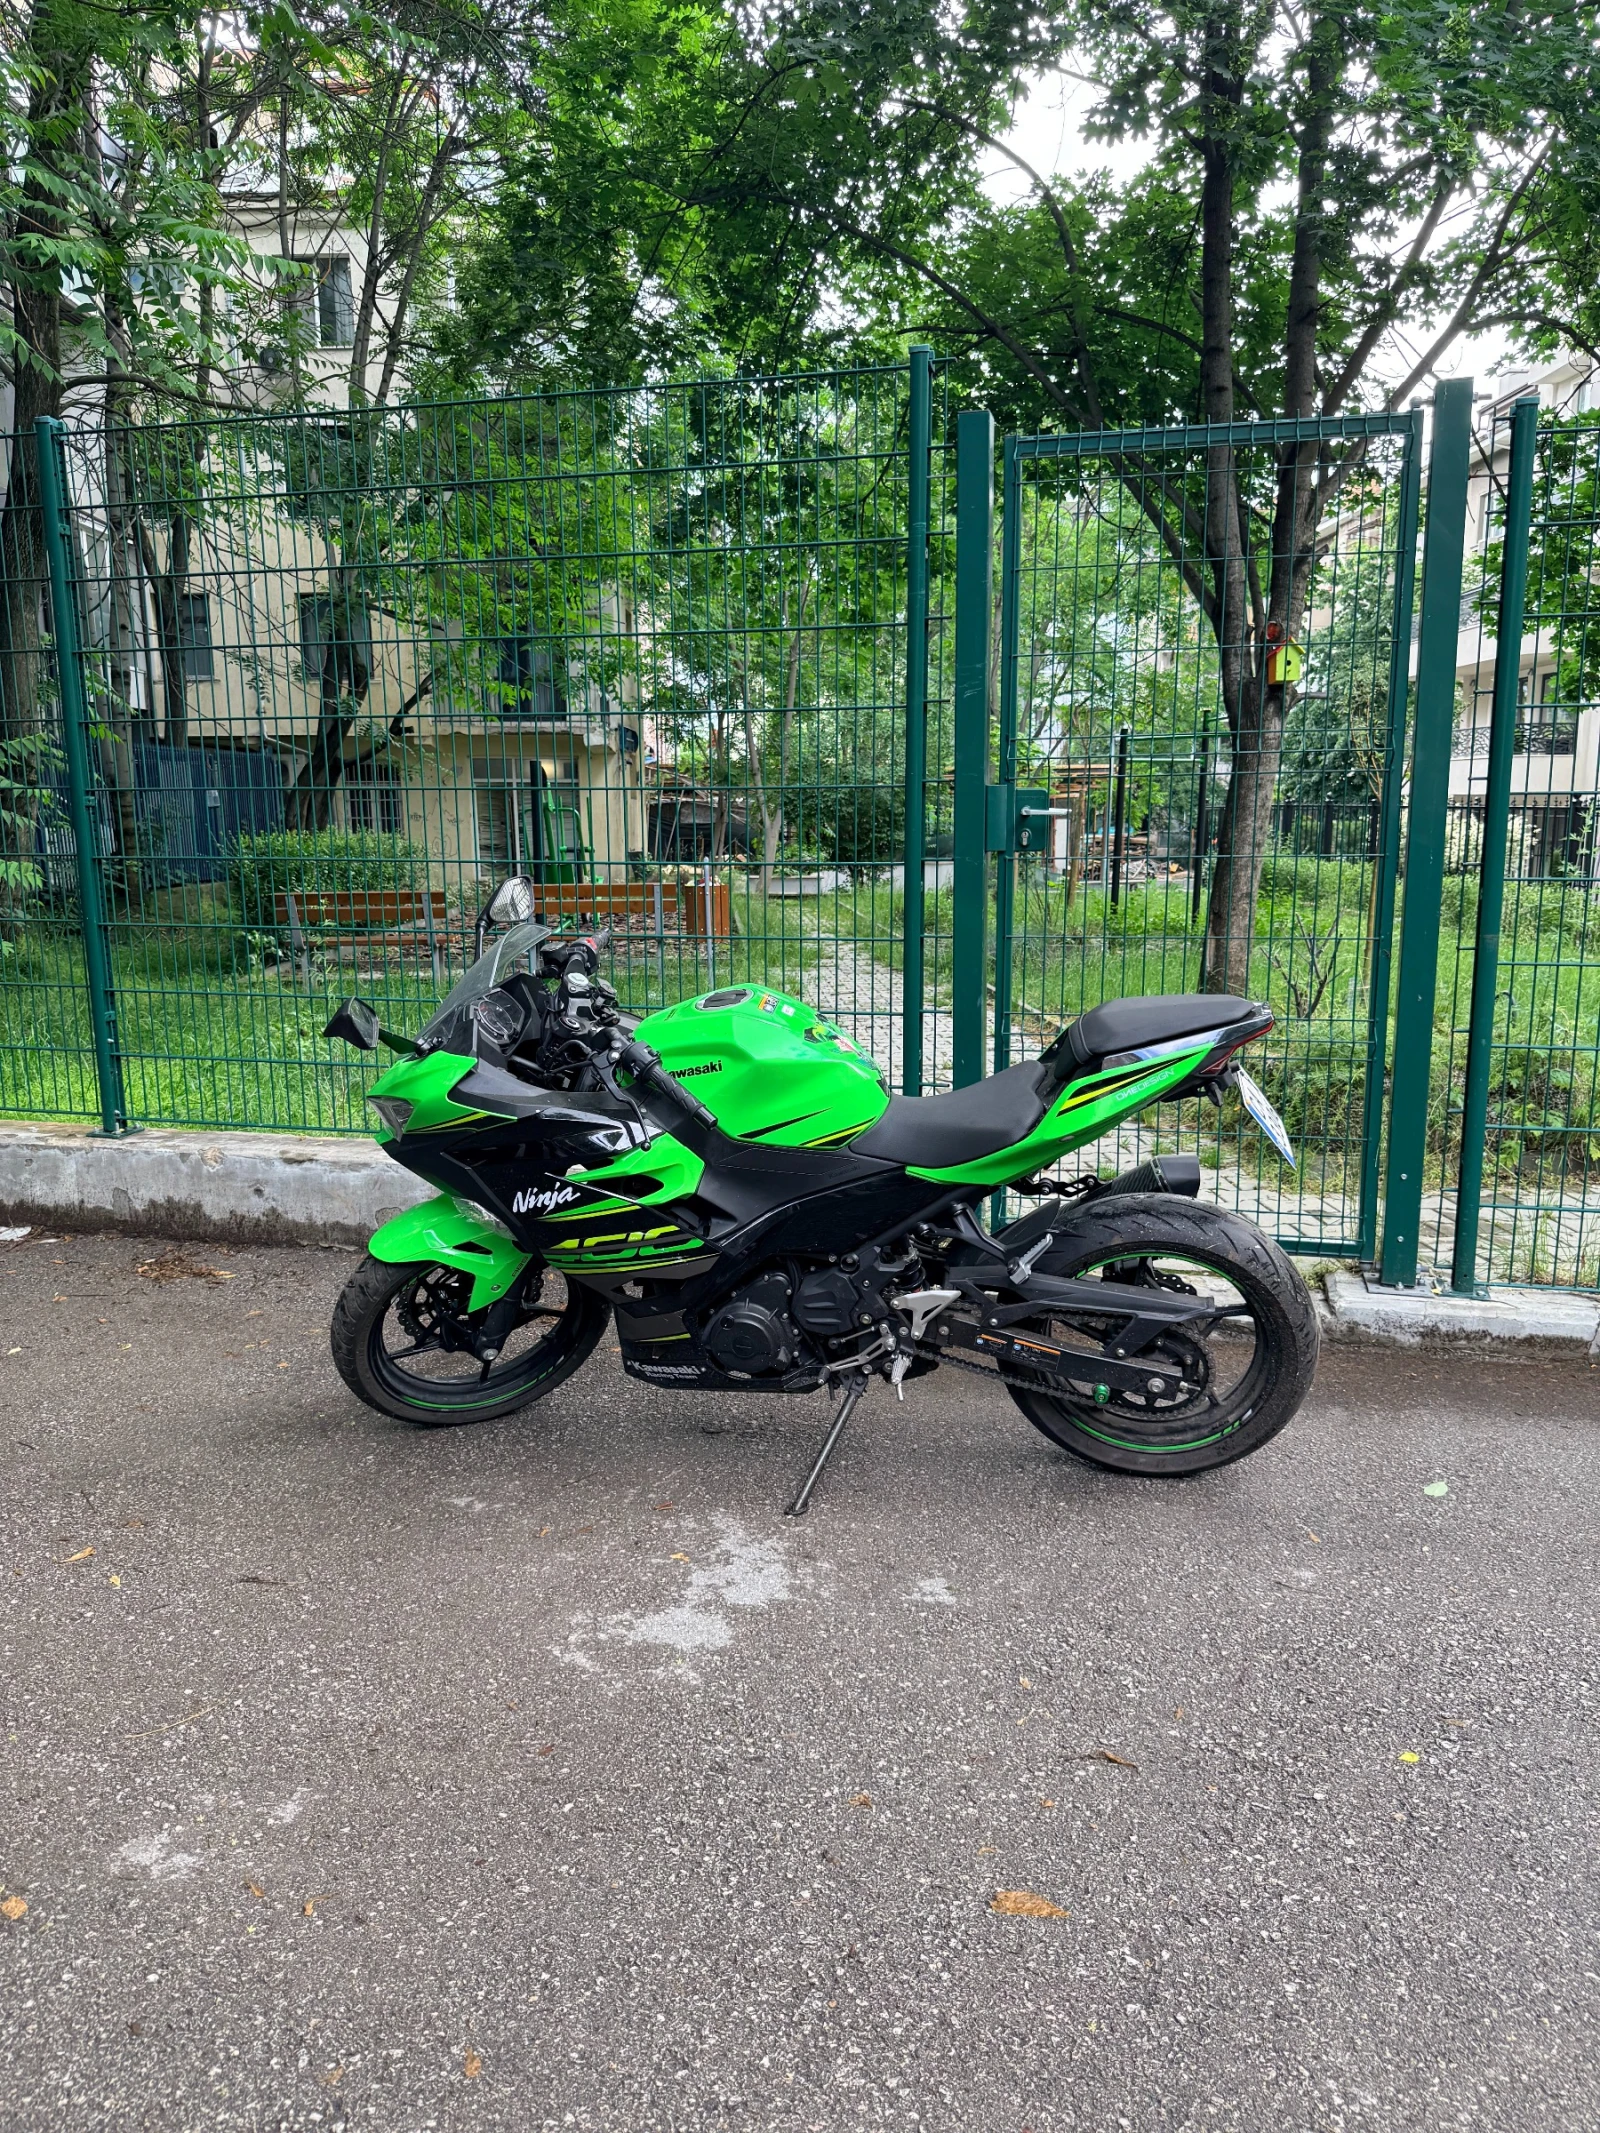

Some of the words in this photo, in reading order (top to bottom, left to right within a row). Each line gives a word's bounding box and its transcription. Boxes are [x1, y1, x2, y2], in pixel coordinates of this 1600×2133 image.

[665, 1060, 722, 1079] awasaki
[1115, 1068, 1175, 1101] ONEDESIGN
[512, 1181, 581, 1215] Ninja
[543, 1225, 705, 1262] 400
[631, 1360, 701, 1375] Kawasaki
